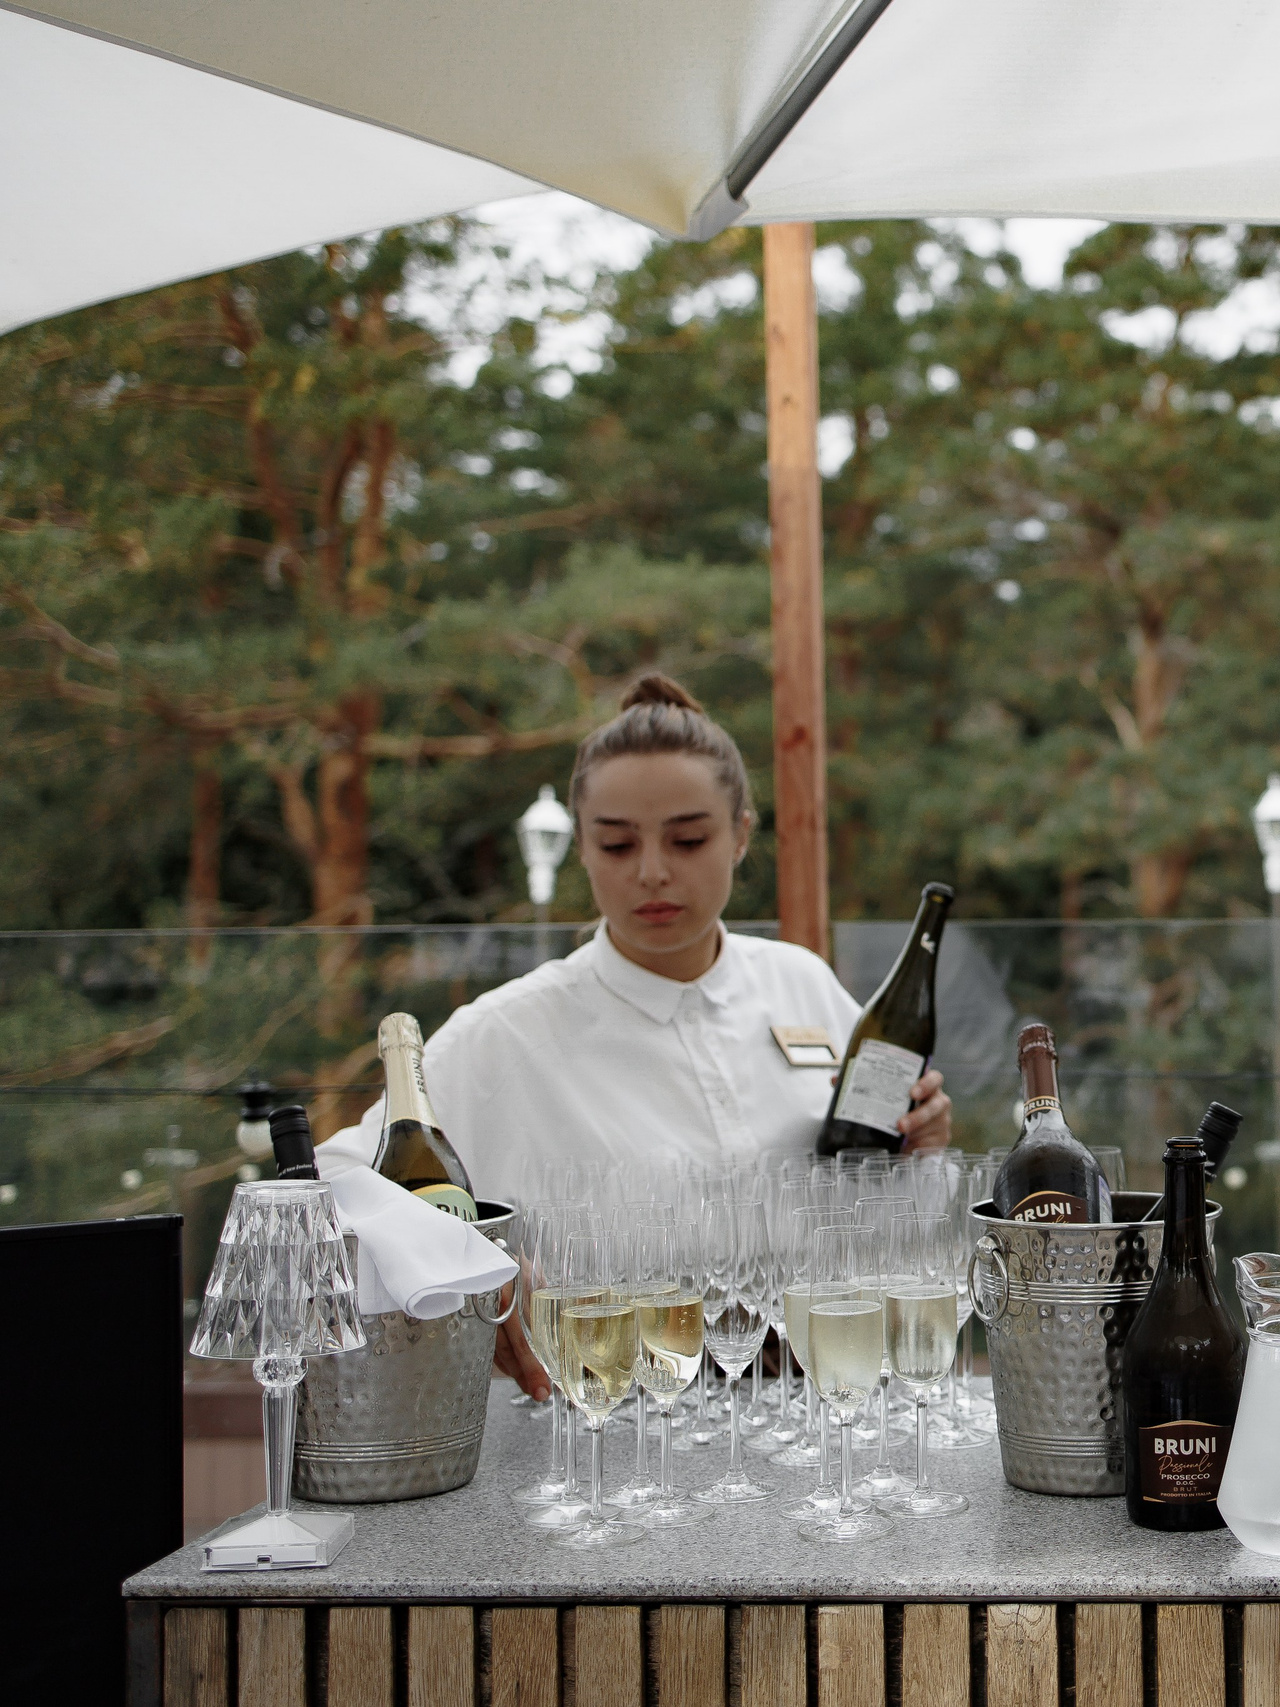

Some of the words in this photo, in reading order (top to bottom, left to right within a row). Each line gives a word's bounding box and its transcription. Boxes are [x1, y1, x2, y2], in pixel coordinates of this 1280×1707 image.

[411, 1057, 427, 1094] BRUNI
[1014, 1202, 1072, 1222] BRUNI
[1154, 1436, 1216, 1455] BRUNI
